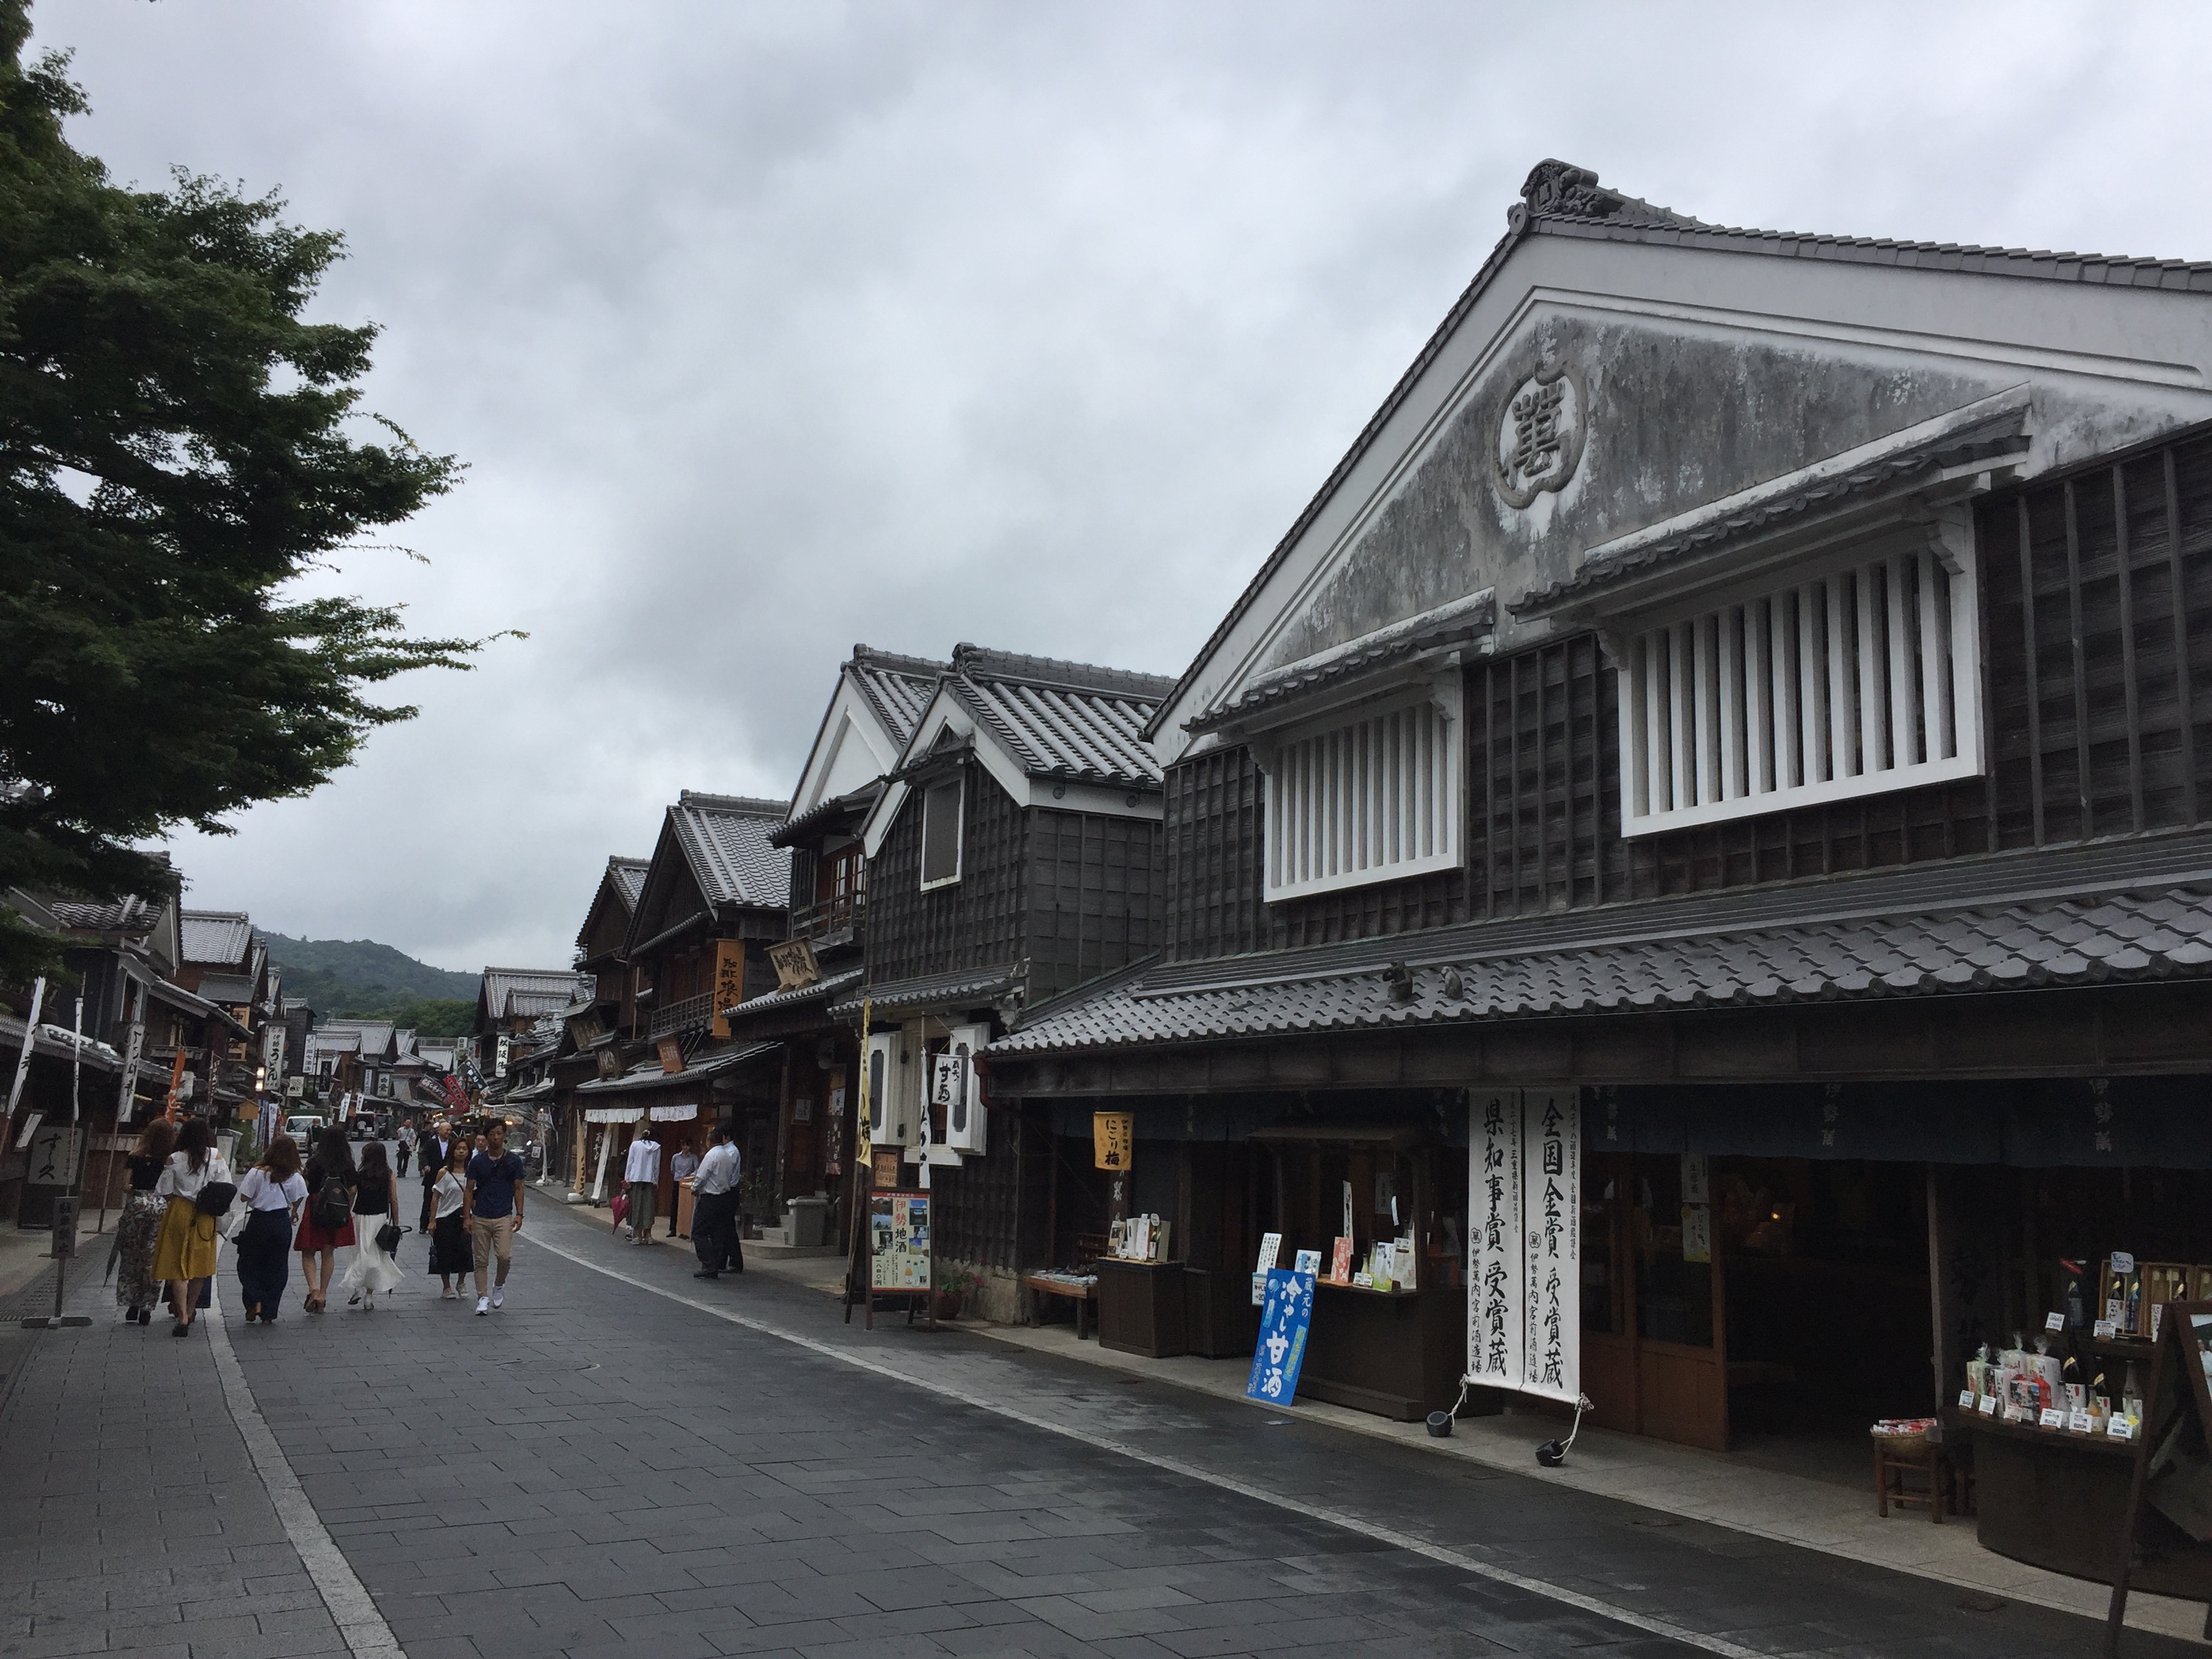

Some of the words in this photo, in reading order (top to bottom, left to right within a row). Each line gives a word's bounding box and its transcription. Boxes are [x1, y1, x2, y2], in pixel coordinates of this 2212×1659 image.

[497, 1039, 508, 1069] 松阪牛
[1105, 1120, 1120, 1166] にごり梅
[1483, 1098, 1507, 1252] 県知事賞
[1541, 1098, 1565, 1259] 全国金賞
[895, 1200, 907, 1253] 伊勢地酒
[1261, 1275, 1303, 1398] 冷やし甘酒
[1301, 1277, 1314, 1317] 蔵元の
[1484, 1260, 1509, 1377] 受賞蔵
[1541, 1267, 1564, 1389] 受賞蔵
